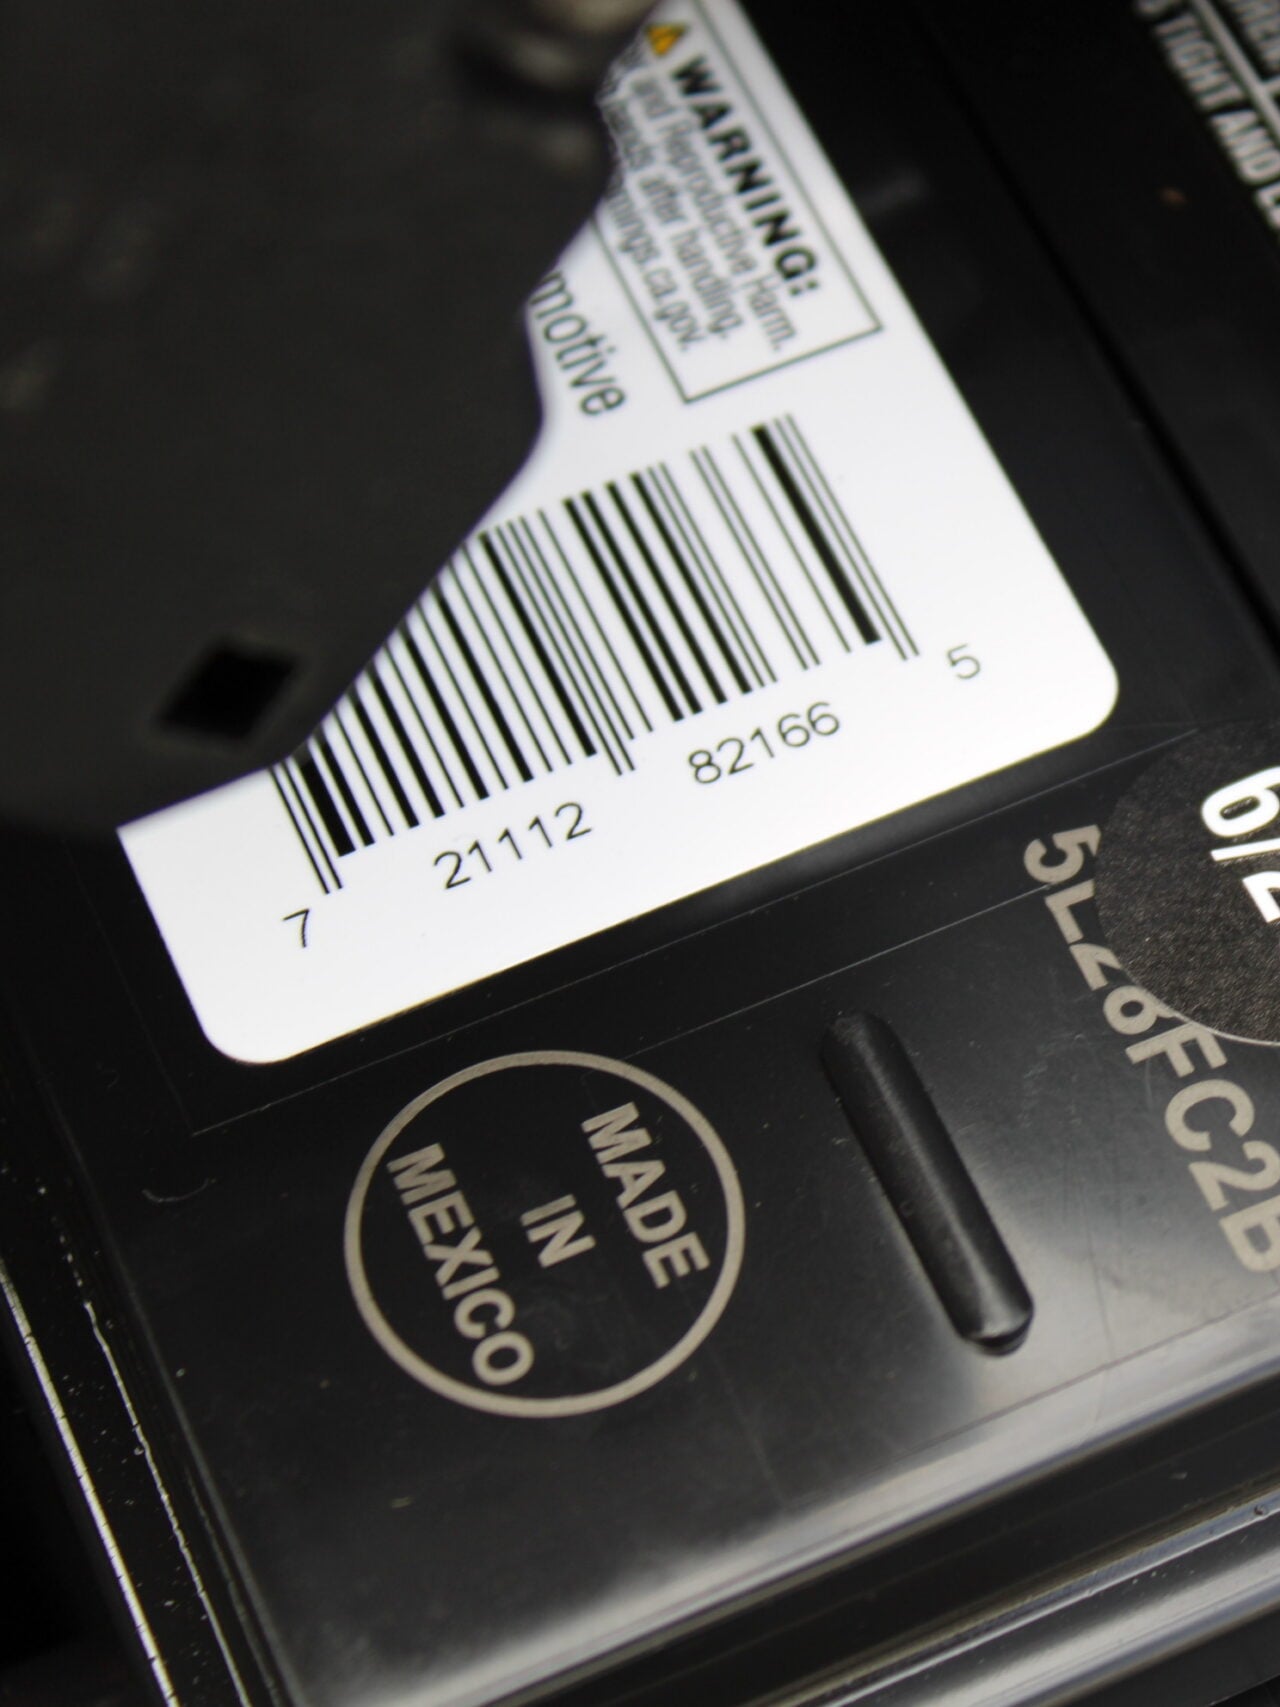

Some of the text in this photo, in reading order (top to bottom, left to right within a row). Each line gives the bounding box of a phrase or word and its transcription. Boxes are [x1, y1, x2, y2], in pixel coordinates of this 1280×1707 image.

[1155, 12, 1246, 110] TIGHT
[638, 172, 690, 224] after
[668, 225, 745, 340] handling.
[653, 116, 758, 277] Reproductive
[738, 270, 797, 351] Harm.
[672, 56, 820, 297] WARNING:
[283, 643, 982, 949] 7 21112 82166 5
[386, 1142, 535, 1387] MEXICO
[521, 1194, 597, 1269] IN
[581, 1101, 711, 1290] MADE
